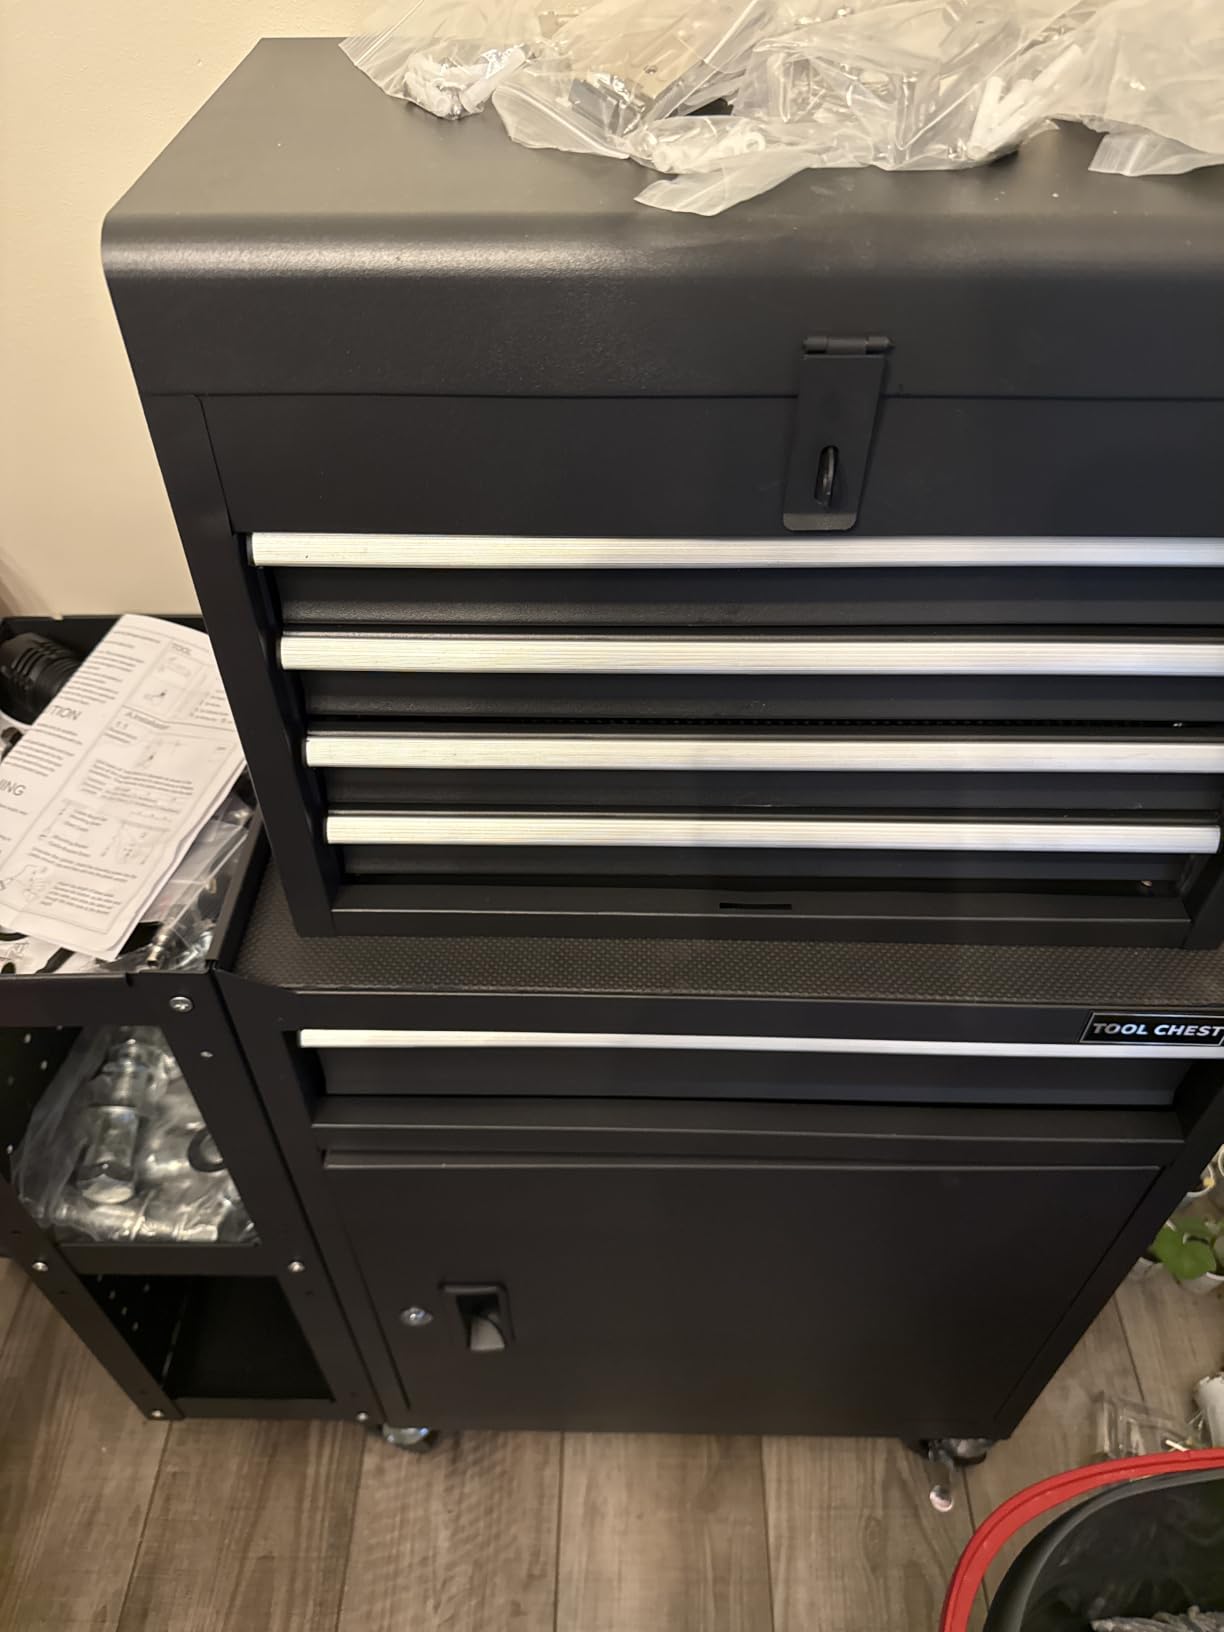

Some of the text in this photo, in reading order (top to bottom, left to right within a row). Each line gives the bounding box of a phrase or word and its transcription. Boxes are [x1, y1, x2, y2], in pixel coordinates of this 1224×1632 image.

[0, 778, 26, 797] ING
[1092, 1022, 1224, 1037] TOOL CHEST
